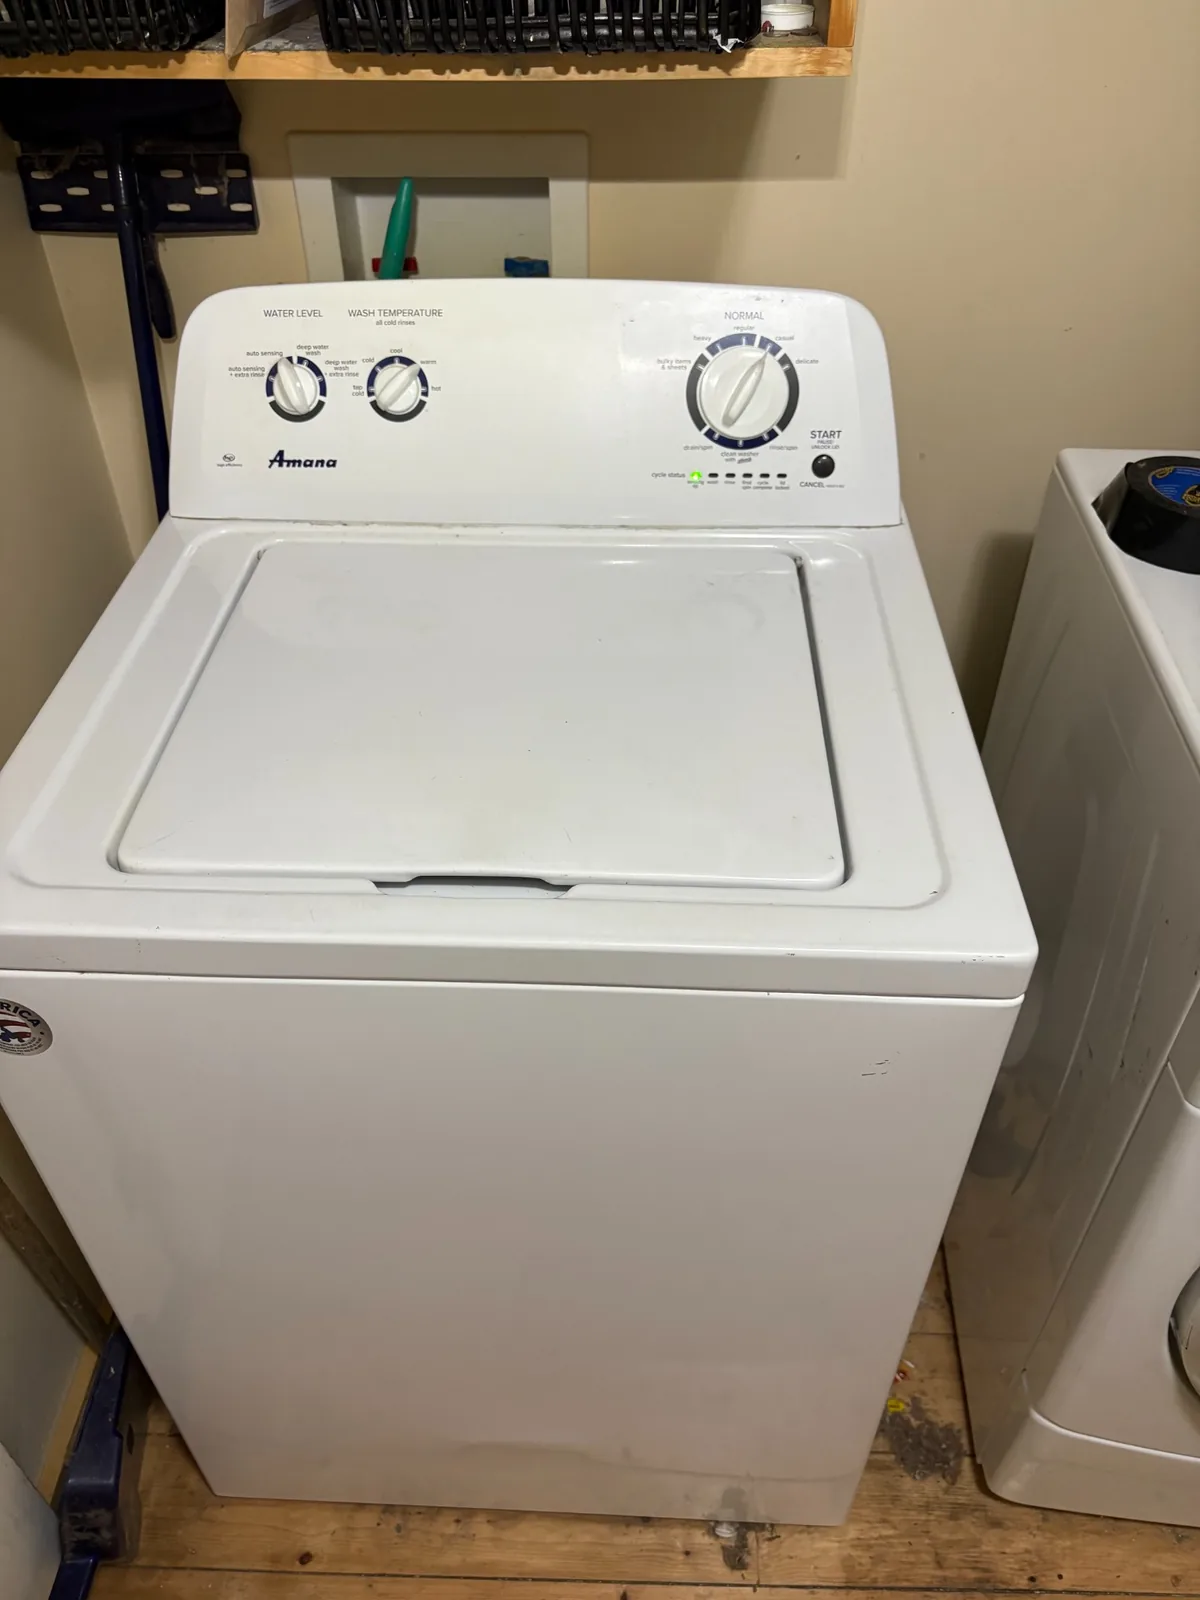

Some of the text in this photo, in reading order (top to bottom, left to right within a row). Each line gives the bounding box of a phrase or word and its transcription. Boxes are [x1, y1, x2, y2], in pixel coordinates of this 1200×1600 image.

[263, 309, 323, 318] WATER LEVEL
[348, 309, 443, 317] WASH TEMPERATURE
[724, 311, 764, 320] NORMAL
[810, 430, 842, 439] START
[268, 449, 338, 469] Amana
